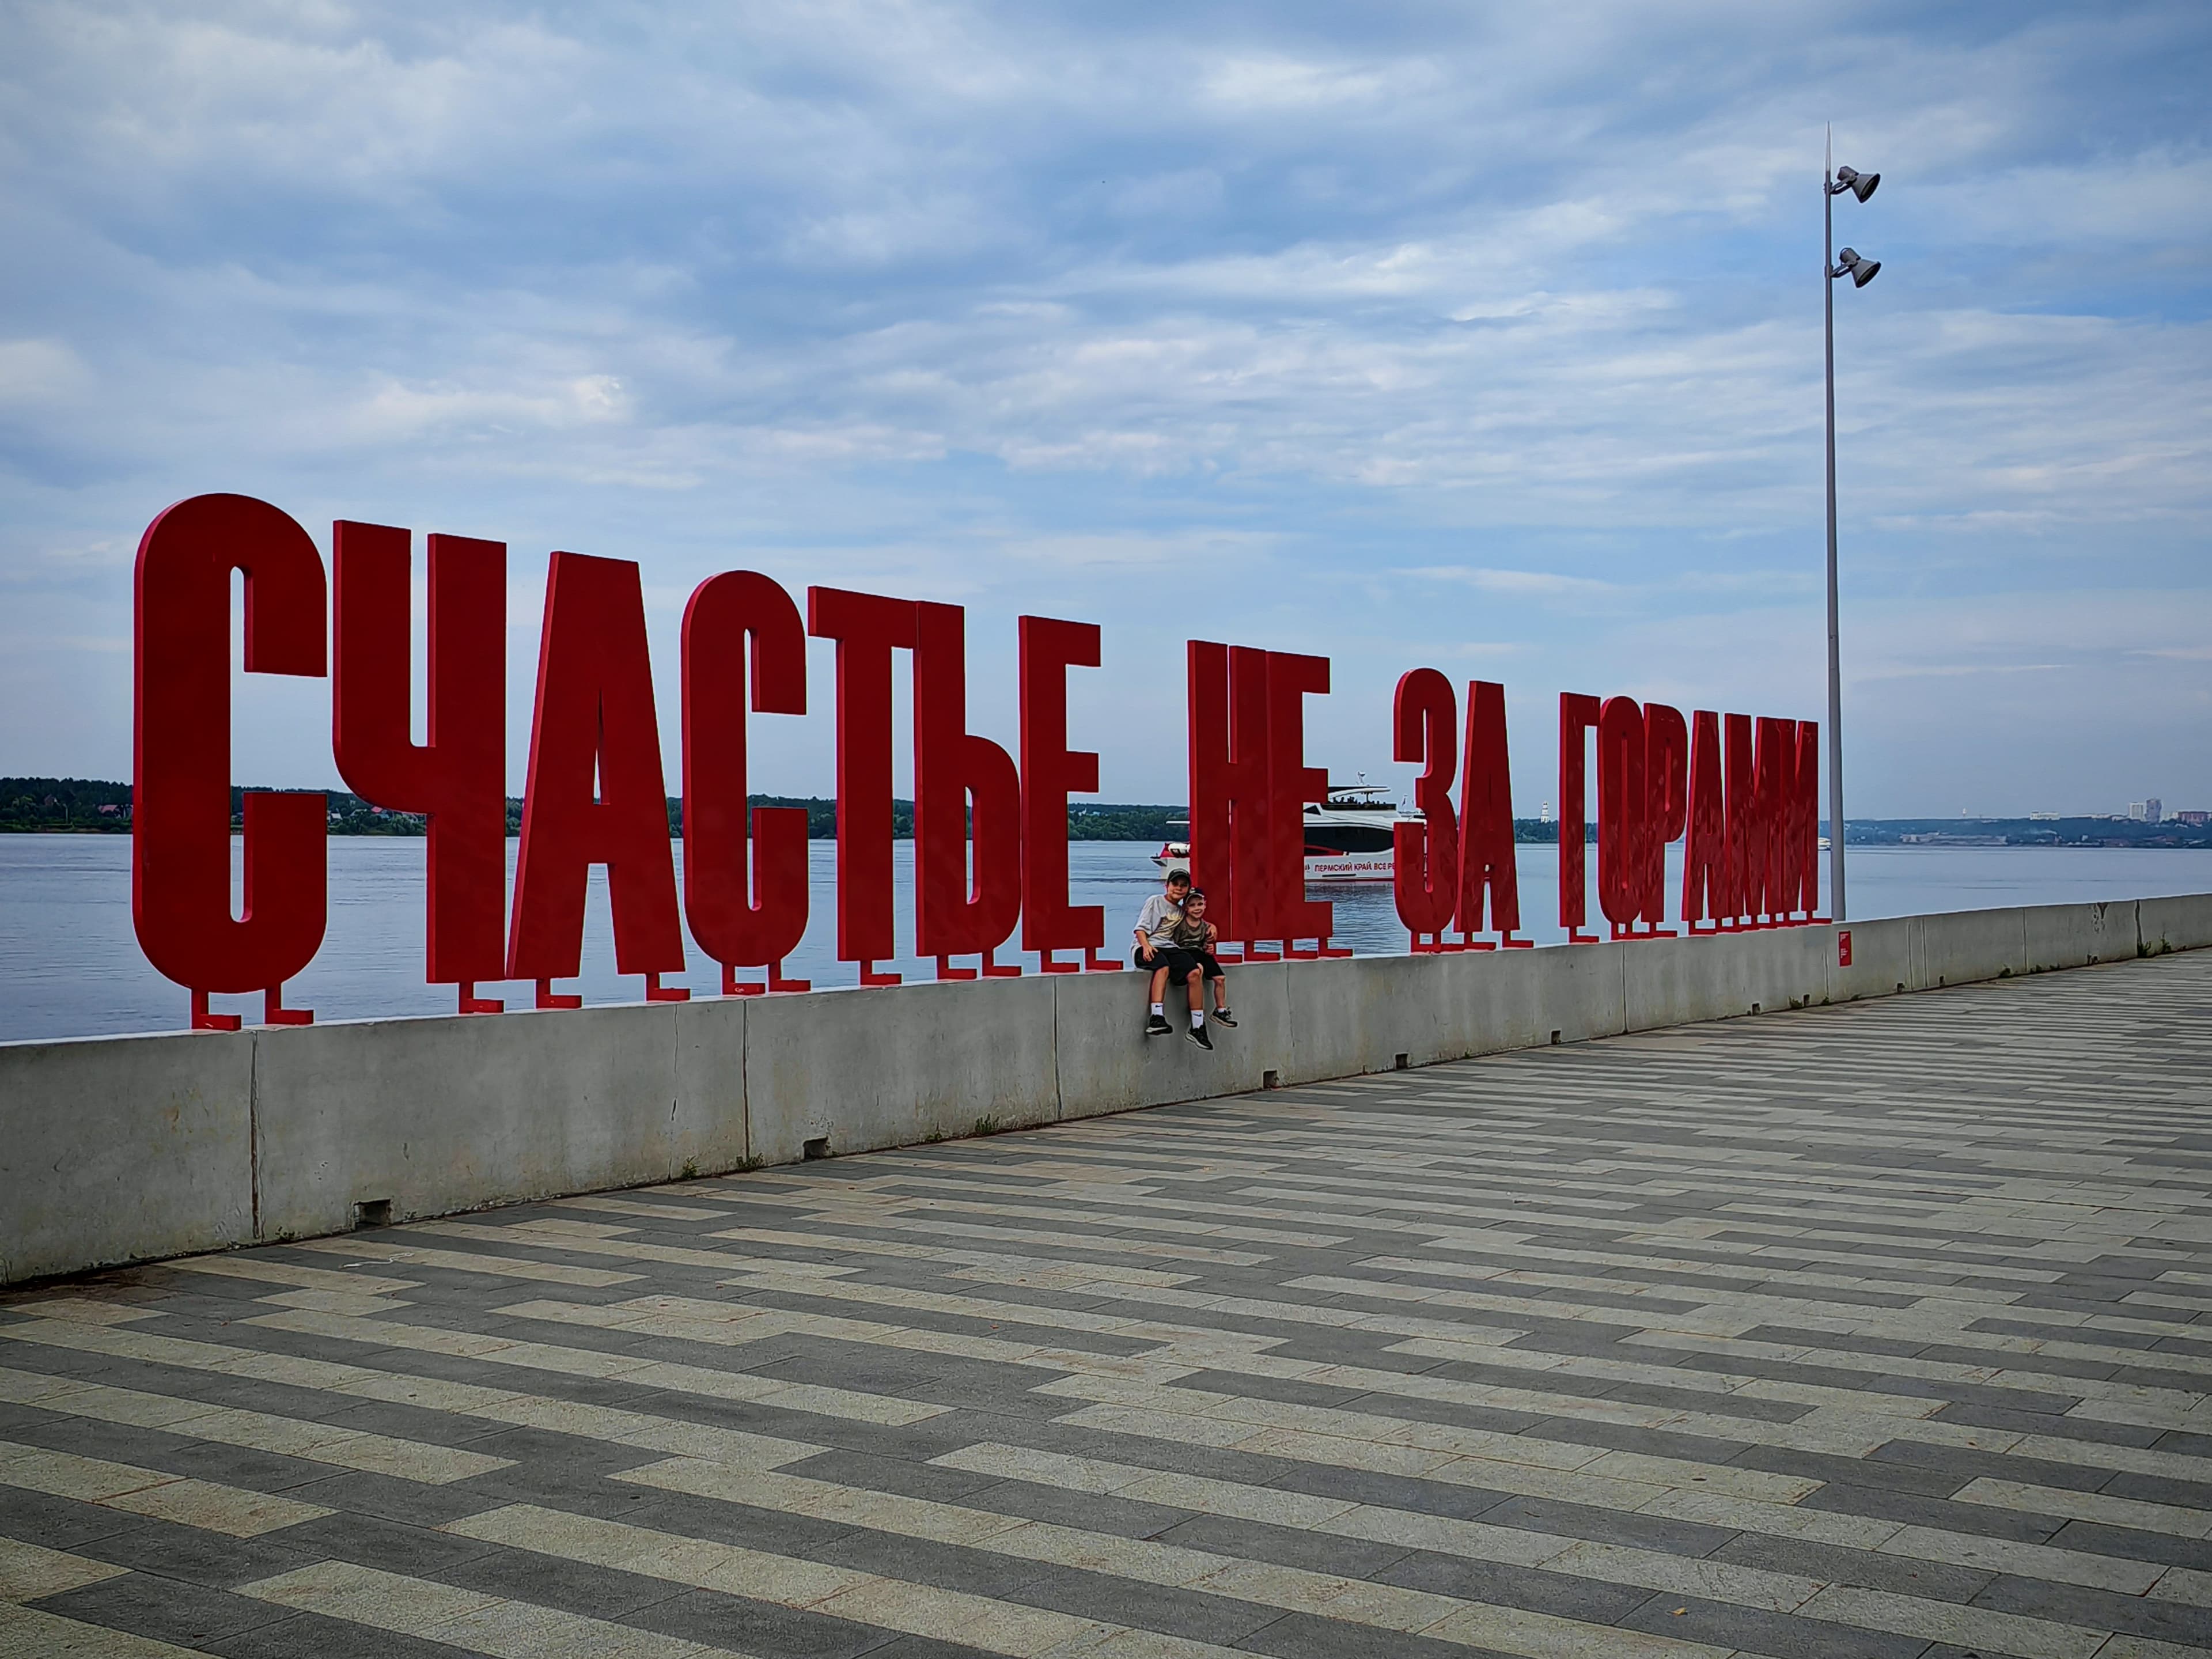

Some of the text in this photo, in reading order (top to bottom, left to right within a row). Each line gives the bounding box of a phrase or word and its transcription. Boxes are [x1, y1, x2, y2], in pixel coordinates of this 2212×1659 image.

[134, 493, 1818, 993] СЧАСТЬЕ НЕ ЗА ГОРАМИ
[1315, 862, 1352, 872] ПЕРМСКИЙ
[1354, 861, 1372, 870] КРАЙ
